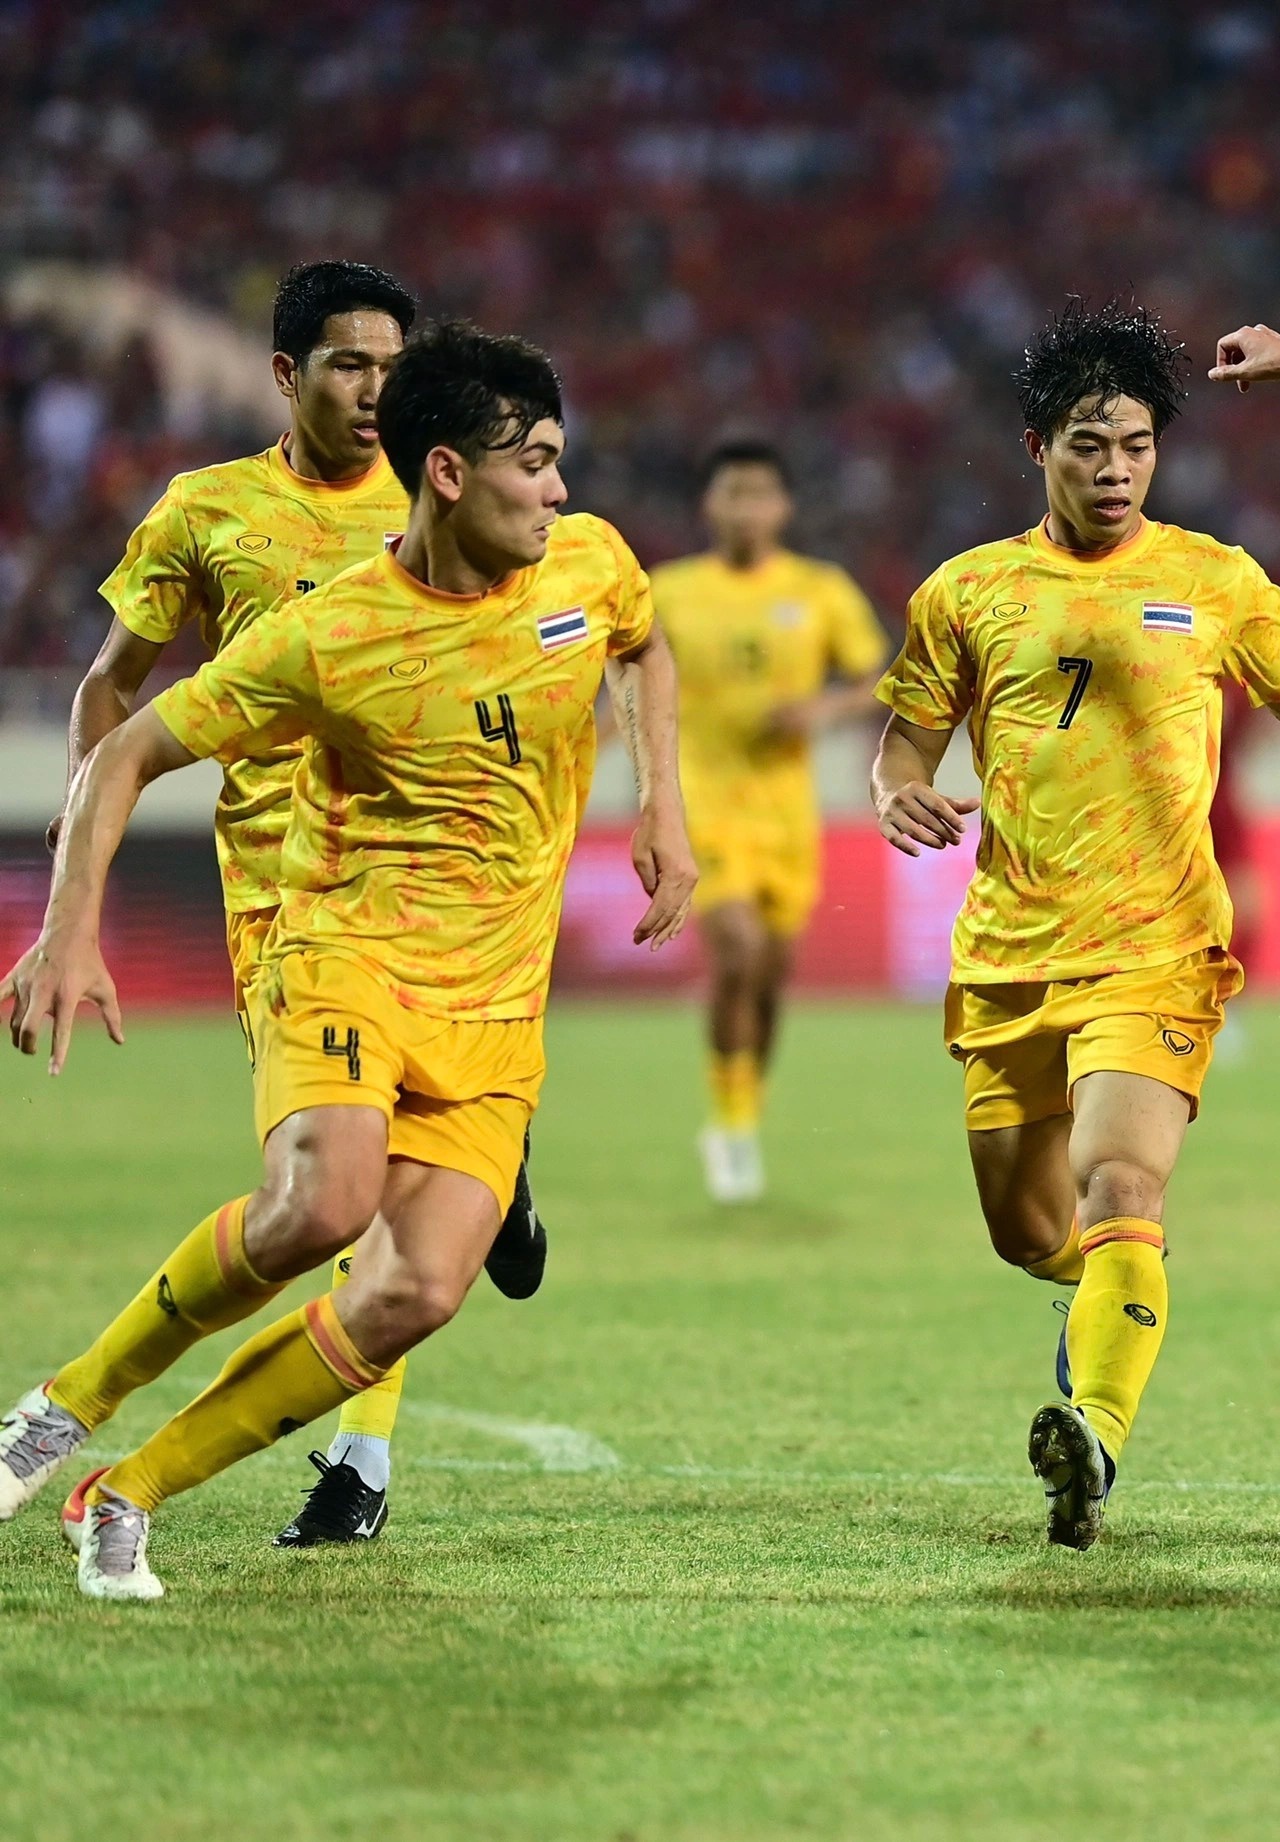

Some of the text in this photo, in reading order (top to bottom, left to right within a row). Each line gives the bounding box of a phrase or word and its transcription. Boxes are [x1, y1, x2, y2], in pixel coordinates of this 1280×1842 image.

[474, 693, 522, 765] 4
[1057, 656, 1093, 730] 7
[323, 1026, 360, 1081] 4
